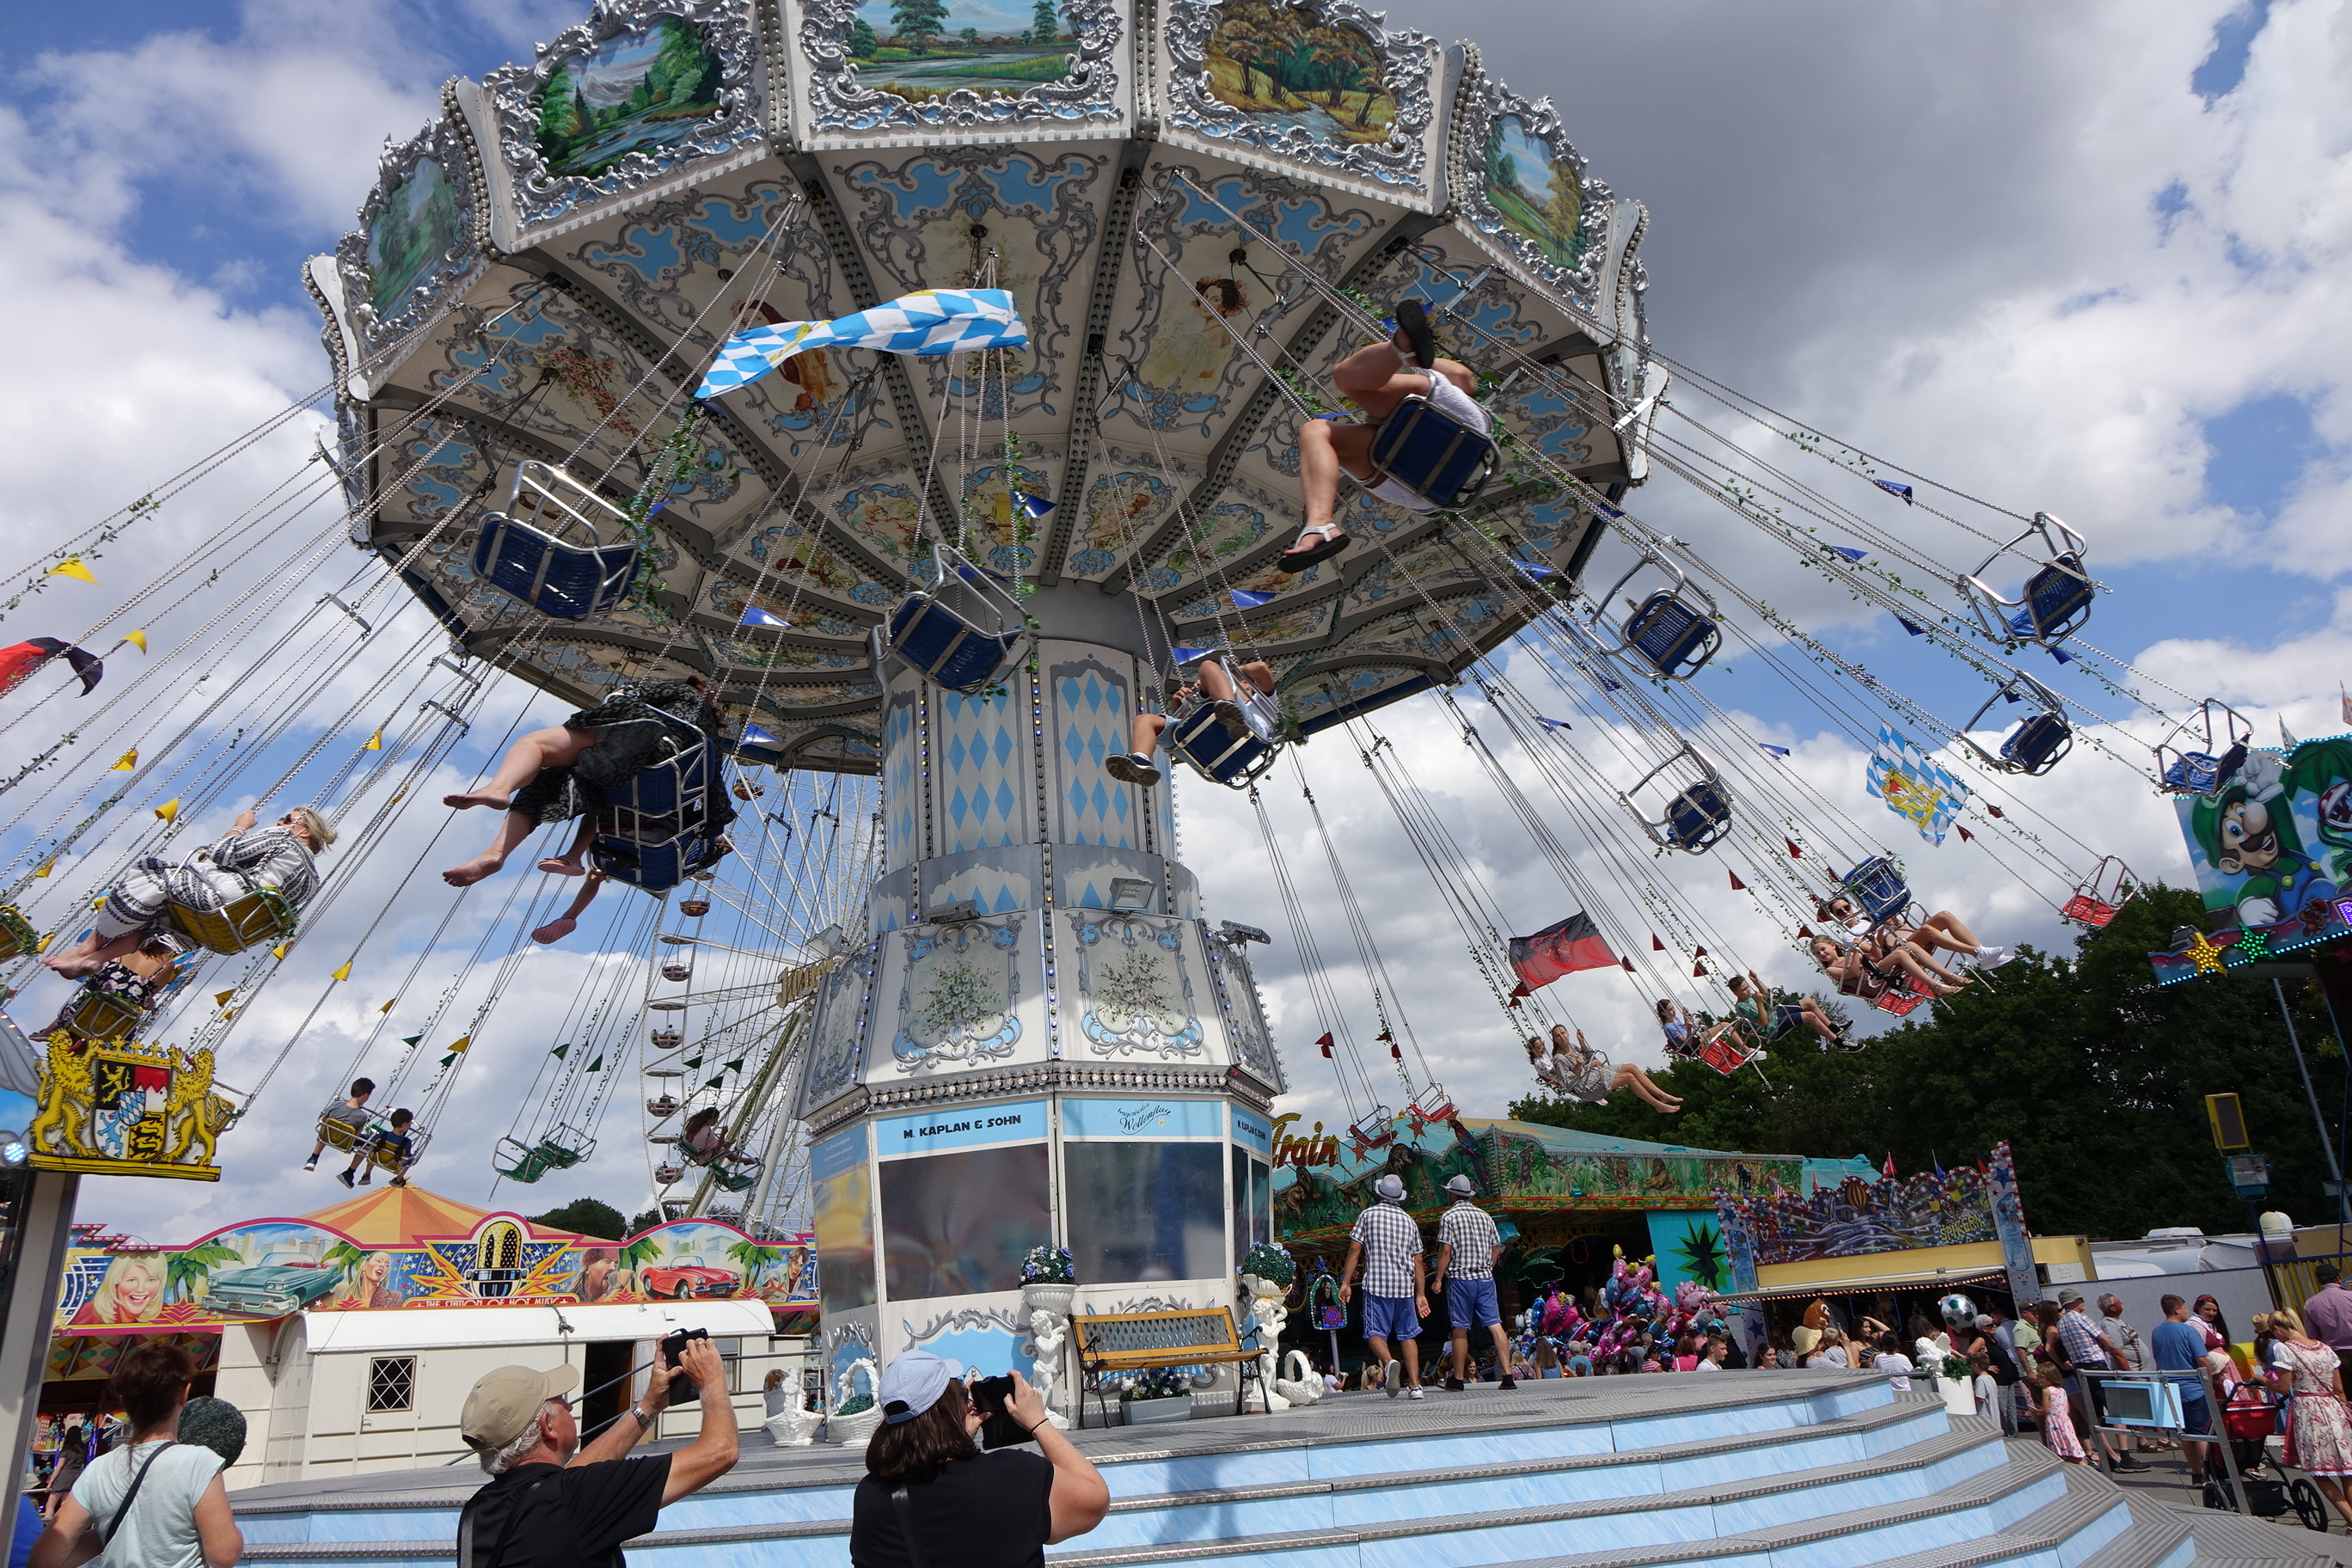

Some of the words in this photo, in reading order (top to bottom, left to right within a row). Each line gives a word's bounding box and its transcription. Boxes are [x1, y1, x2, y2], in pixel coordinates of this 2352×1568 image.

[903, 1129, 916, 1139] M.
[919, 1121, 971, 1137] KAPLAN
[987, 1115, 1021, 1128] SOHN
[1119, 1105, 1172, 1131] Wellenflug
[1272, 1112, 1338, 1169] Train
